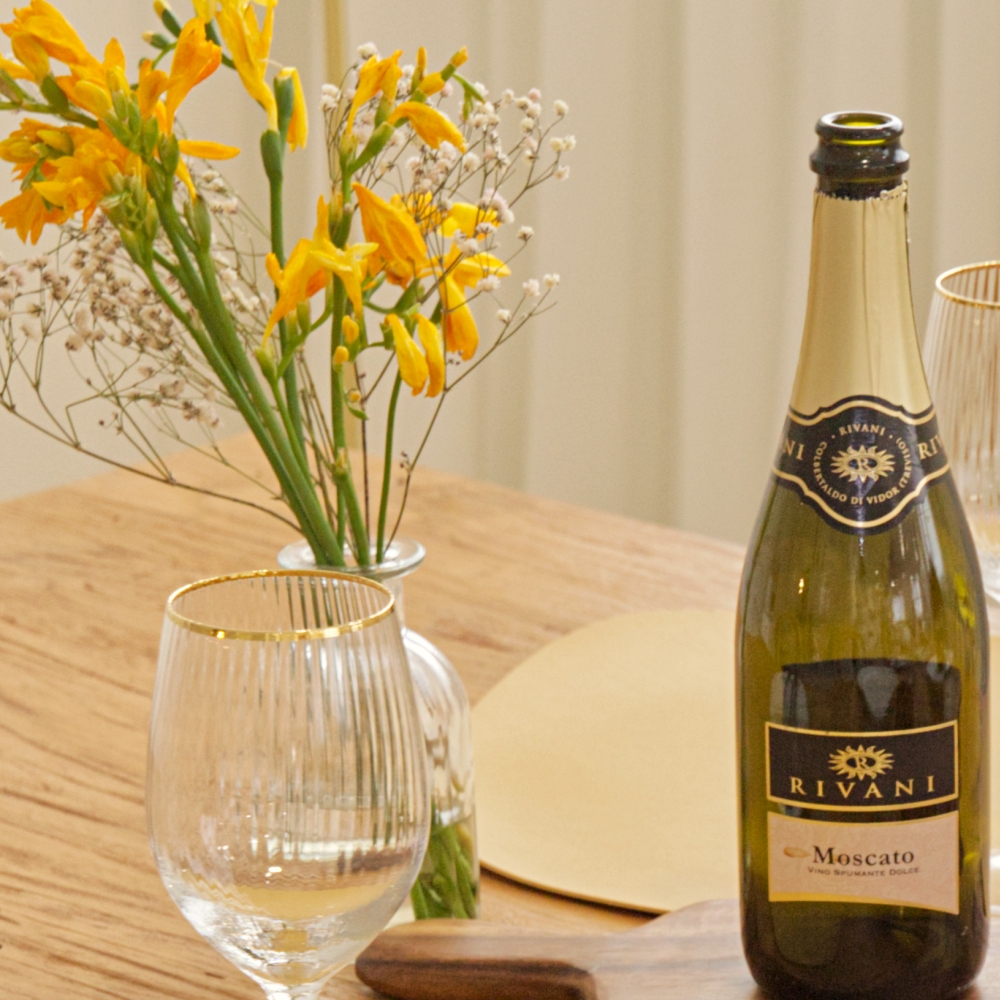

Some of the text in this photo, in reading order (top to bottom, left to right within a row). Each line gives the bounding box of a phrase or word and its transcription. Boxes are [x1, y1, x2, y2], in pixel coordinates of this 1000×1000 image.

[839, 424, 885, 436] RIVANI
[813, 441, 848, 502] COLBERTALDO
[850, 496, 864, 505] DI
[866, 487, 900, 504] VIDOR
[789, 775, 936, 799] RIVANI
[813, 845, 915, 866] Moscato
